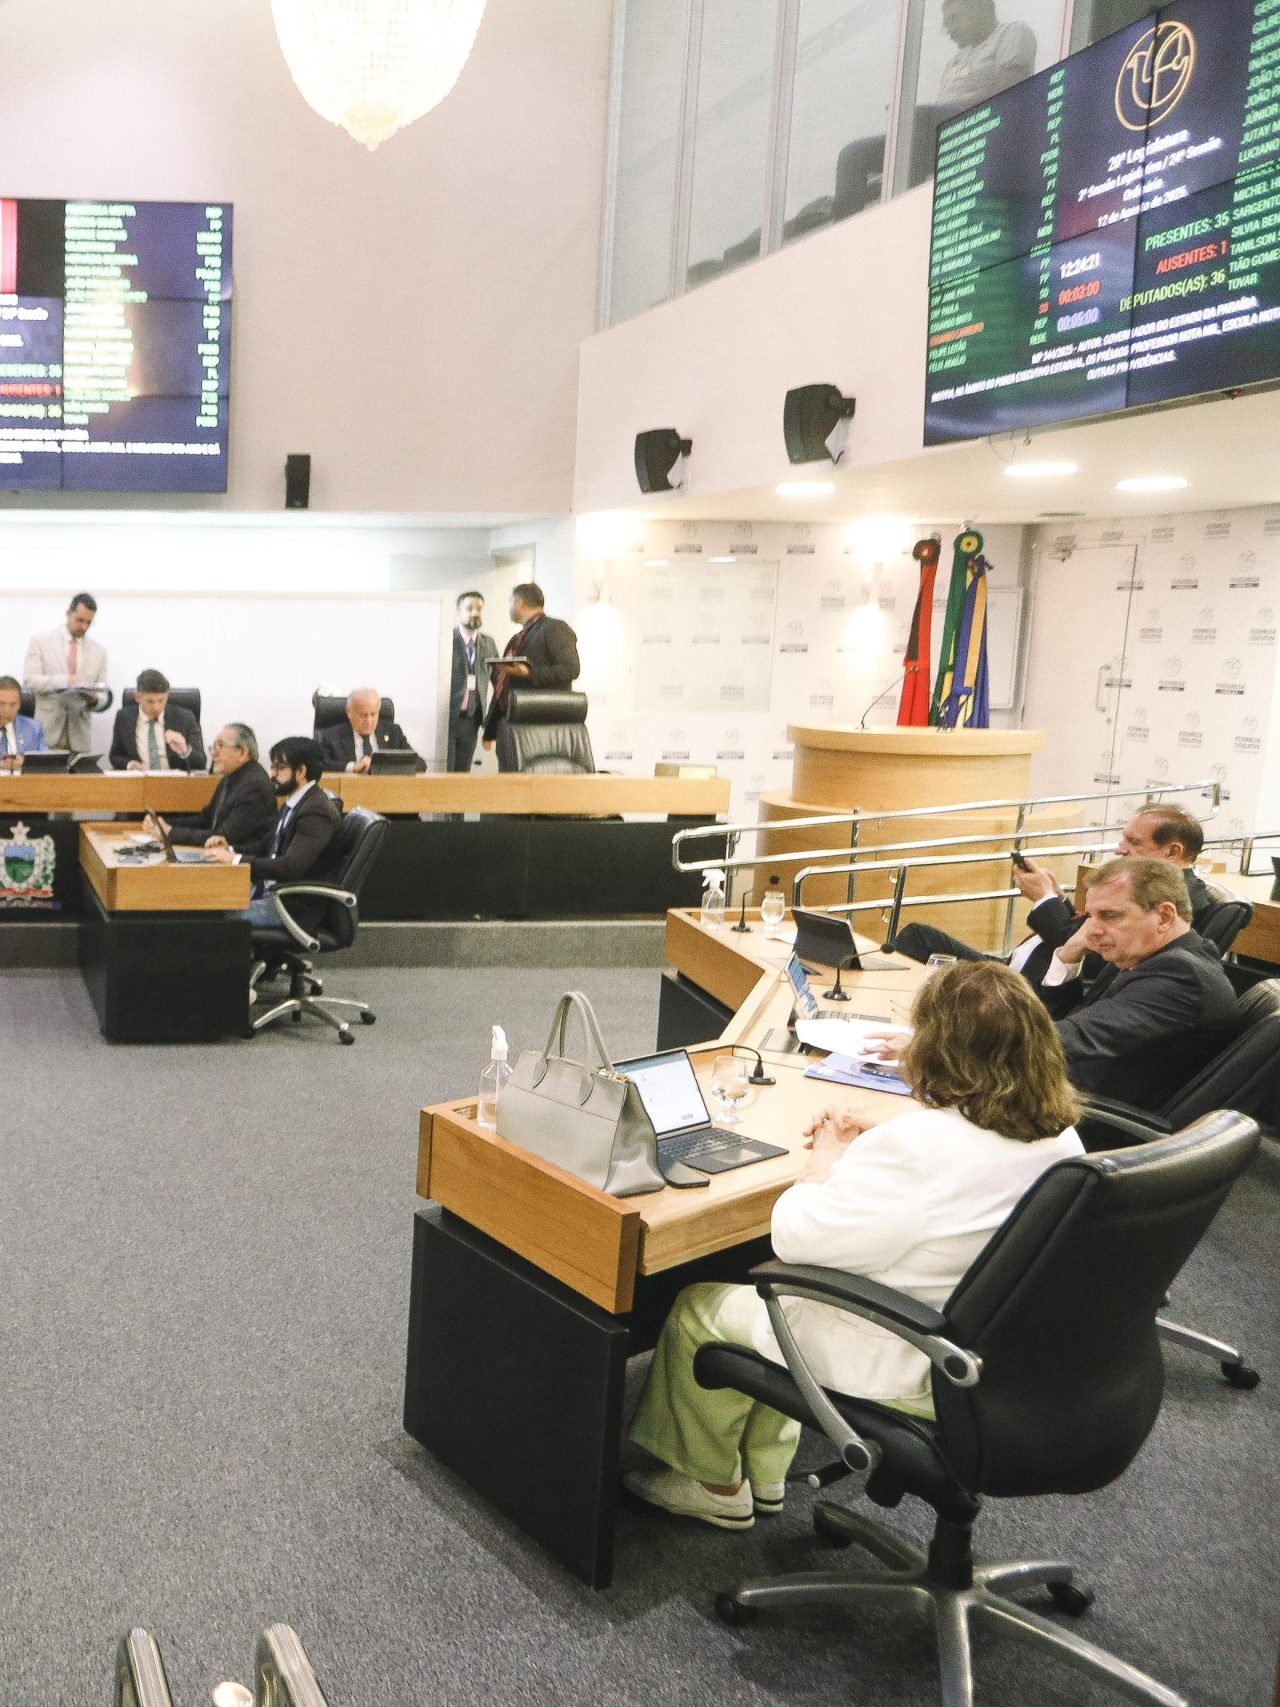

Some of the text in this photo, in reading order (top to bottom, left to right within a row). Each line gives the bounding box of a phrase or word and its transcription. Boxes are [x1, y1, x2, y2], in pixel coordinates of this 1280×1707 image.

[1145, 211, 1229, 252] PRESENTES: 35
[1155, 239, 1228, 275] AUSENTES: 1
[1229, 248, 1280, 273] TIÃO GOME
[1210, 268, 1226, 287] 36
[1228, 272, 1258, 291] TOVAR
